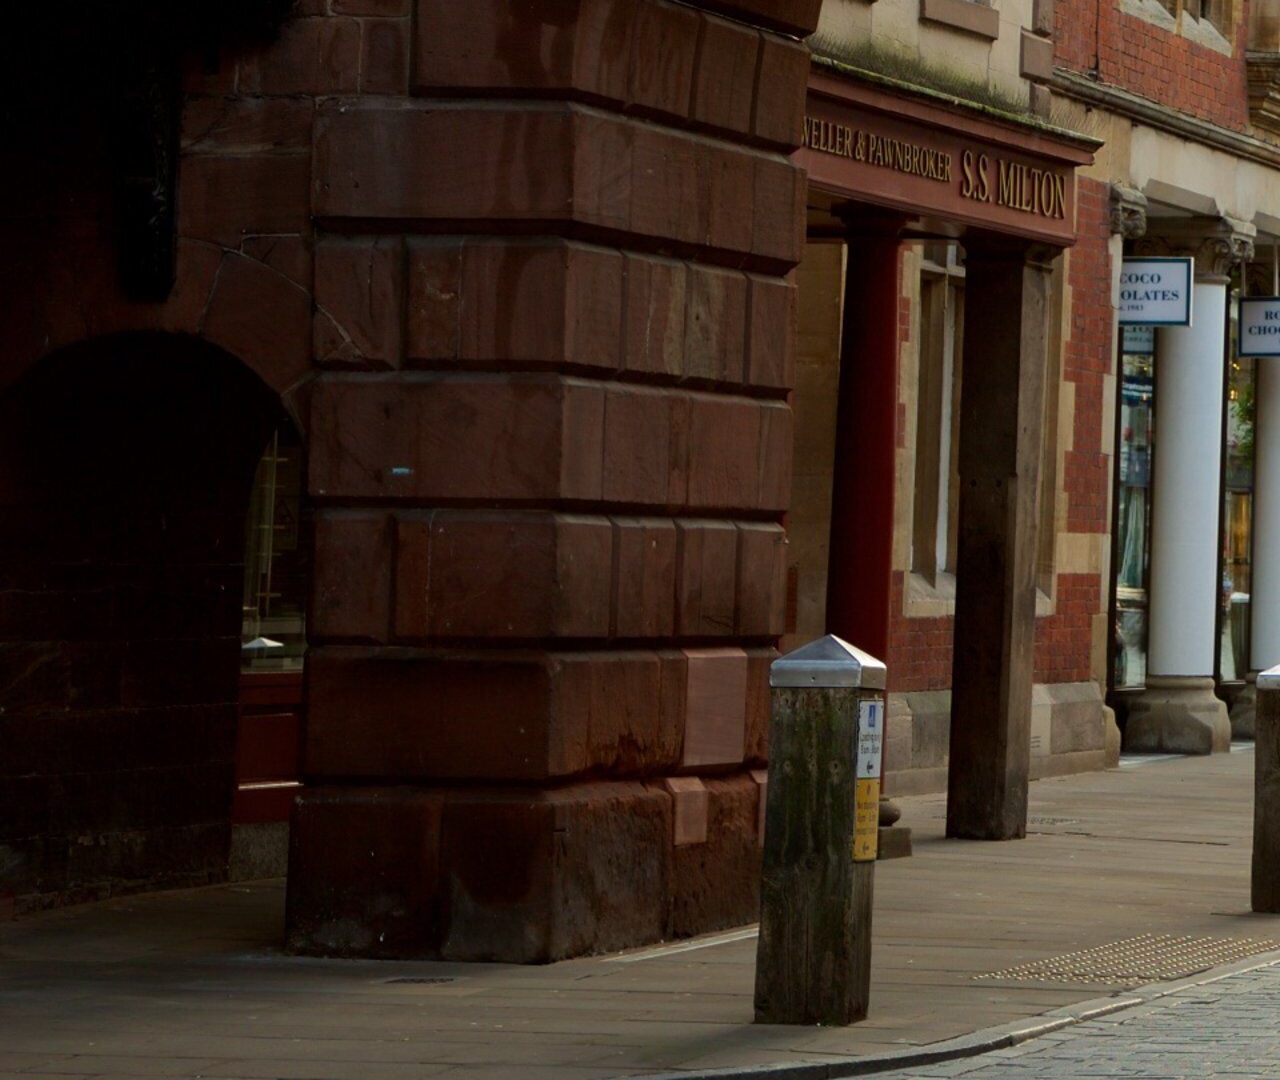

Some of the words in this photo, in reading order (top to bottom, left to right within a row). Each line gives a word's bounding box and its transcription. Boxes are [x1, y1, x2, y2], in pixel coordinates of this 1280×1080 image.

[855, 129, 866, 161] &
[868, 133, 952, 183] PAWNBROKER
[998, 159, 1066, 220] MILTON
[1120, 273, 1161, 284] COCO
[1121, 290, 1179, 301] OLATES
